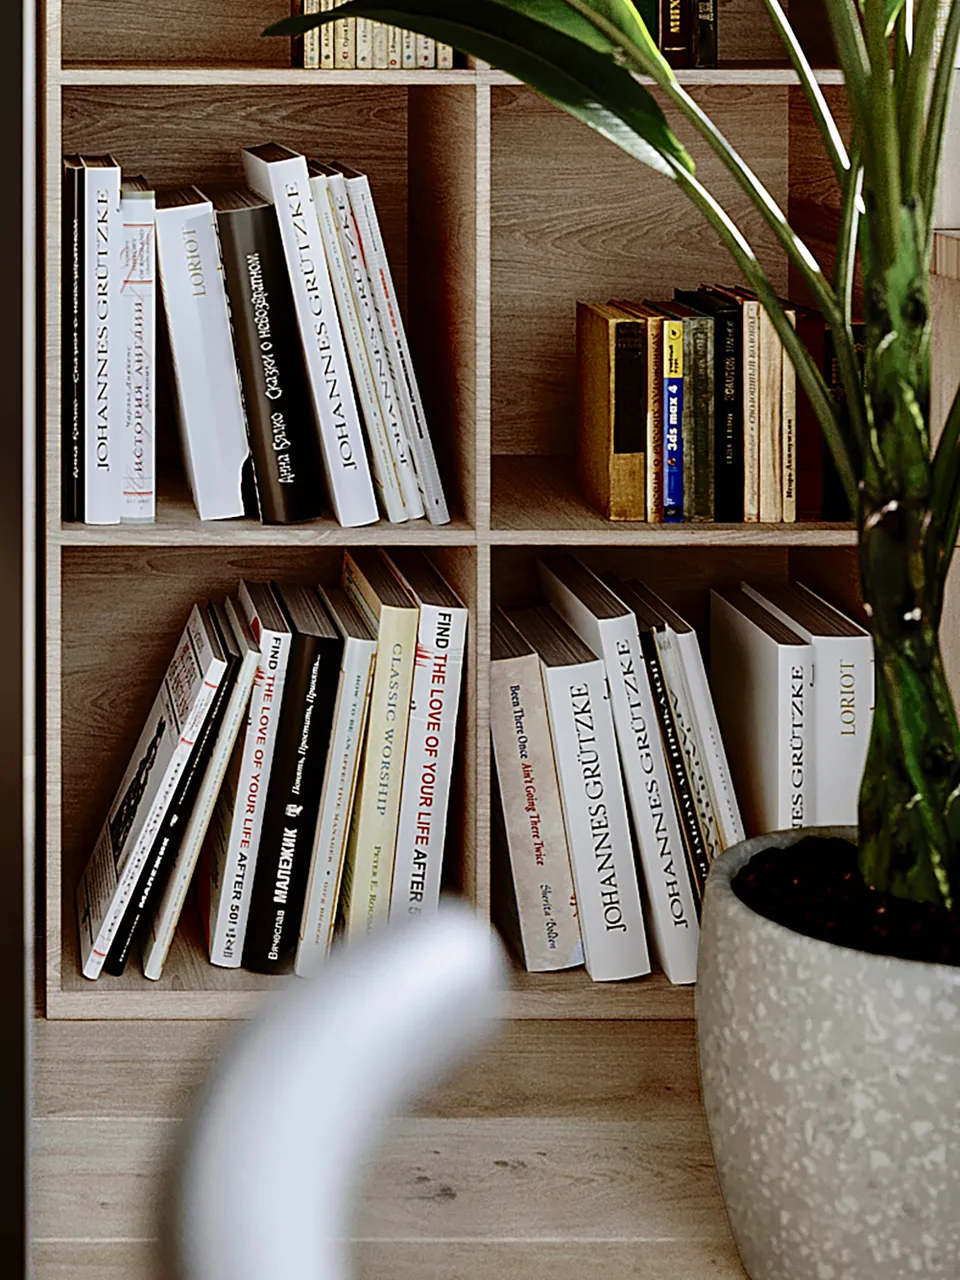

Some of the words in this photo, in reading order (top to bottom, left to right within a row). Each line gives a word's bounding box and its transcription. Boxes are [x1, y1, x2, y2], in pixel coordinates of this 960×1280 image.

[94, 189, 108, 319] GRÜTZKE
[181, 226, 206, 297] LORIOT
[286, 182, 321, 316] GRÜTZKE
[246, 252, 273, 338] невозвратном
[133, 301, 143, 376] АНГЛИИ
[260, 340, 273, 351] о
[261, 353, 282, 399] Сказки
[651, 332, 660, 404] художниках
[667, 384, 678, 394] 4
[96, 325, 110, 471] JOHANNES
[316, 321, 357, 471] JOHANNES
[668, 396, 678, 424] max
[133, 384, 143, 472] ИСТОРИЯ
[270, 412, 291, 450] Бялко
[667, 428, 678, 452] 3ds
[277, 453, 295, 483] Анна
[433, 612, 451, 649] FIND
[268, 636, 281, 670] FIND
[429, 653, 447, 684] THE
[263, 674, 275, 702] THE
[385, 642, 402, 721] CLASSIC
[508, 684, 523, 708] Been
[839, 658, 856, 736] LORIOT
[256, 706, 271, 745] LOVE
[426, 688, 444, 731] LOVE
[513, 707, 525, 735] There
[615, 641, 653, 774] GRÜTZKE
[789, 664, 804, 788] GRÜTZKE
[252, 748, 263, 768] OF
[423, 734, 439, 758] OF
[516, 734, 529, 759] Once
[569, 682, 603, 800] GRÜTZKE
[376, 728, 394, 815] WORSHIP
[418, 762, 436, 807] YOUR
[519, 761, 534, 784] Ain't
[245, 773, 260, 814] YOUR
[523, 785, 539, 812] Going
[239, 817, 253, 847] LIFE
[413, 811, 431, 845] LIFE
[529, 813, 541, 839] There
[138, 837, 169, 908] МАЛЕЖИК
[273, 826, 298, 904] МАЛЕЖИК
[533, 839, 546, 866] Twice
[588, 803, 627, 932] JOHANNES
[647, 779, 688, 928] JOHANNES
[230, 851, 248, 900] AFTER
[408, 848, 427, 901] AFTER
[227, 902, 241, 924] 50!
[267, 909, 285, 960] Вячеслав
